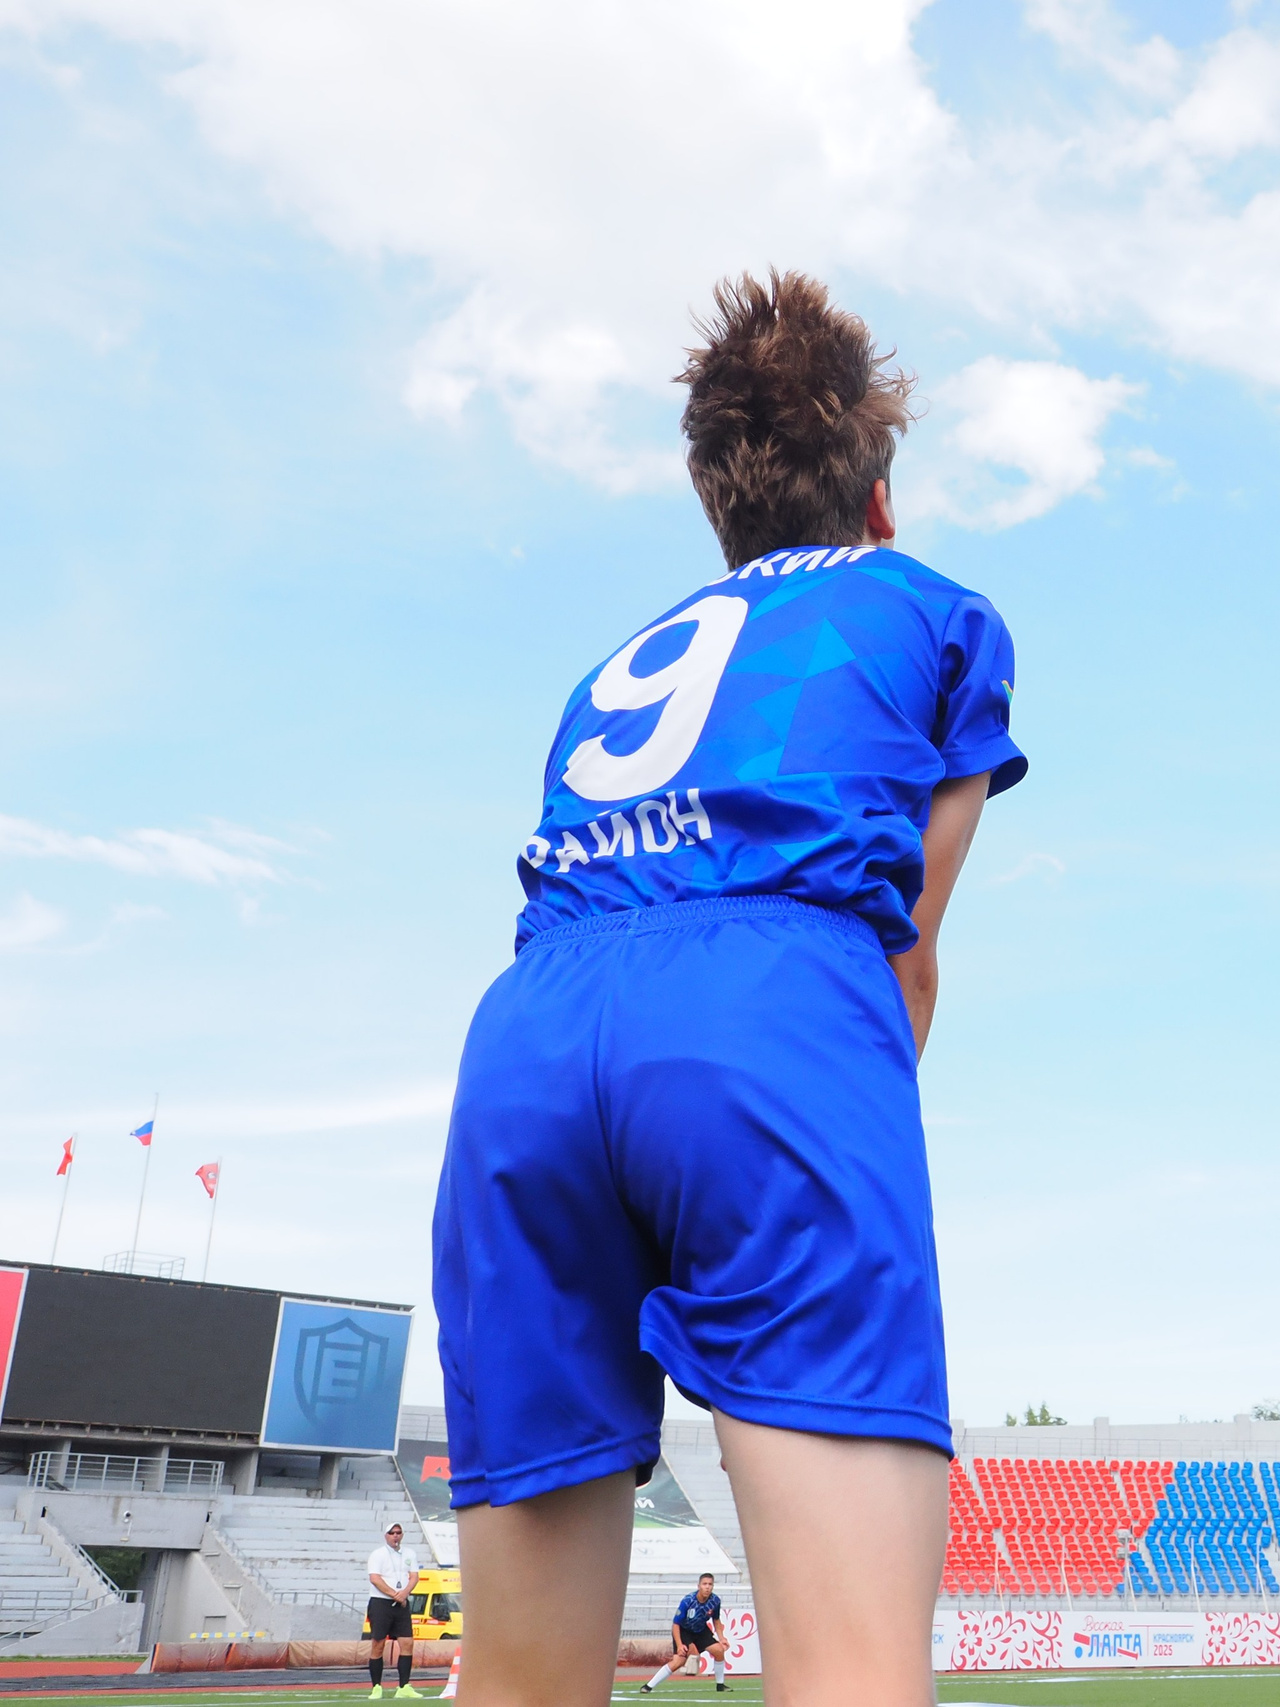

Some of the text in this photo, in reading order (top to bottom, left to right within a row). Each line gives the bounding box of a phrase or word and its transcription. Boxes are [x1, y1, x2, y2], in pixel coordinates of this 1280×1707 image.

[562, 595, 749, 801] 9
[1088, 1633, 1142, 1657] ЛАПТА
[1153, 1644, 1173, 1656] 2025
